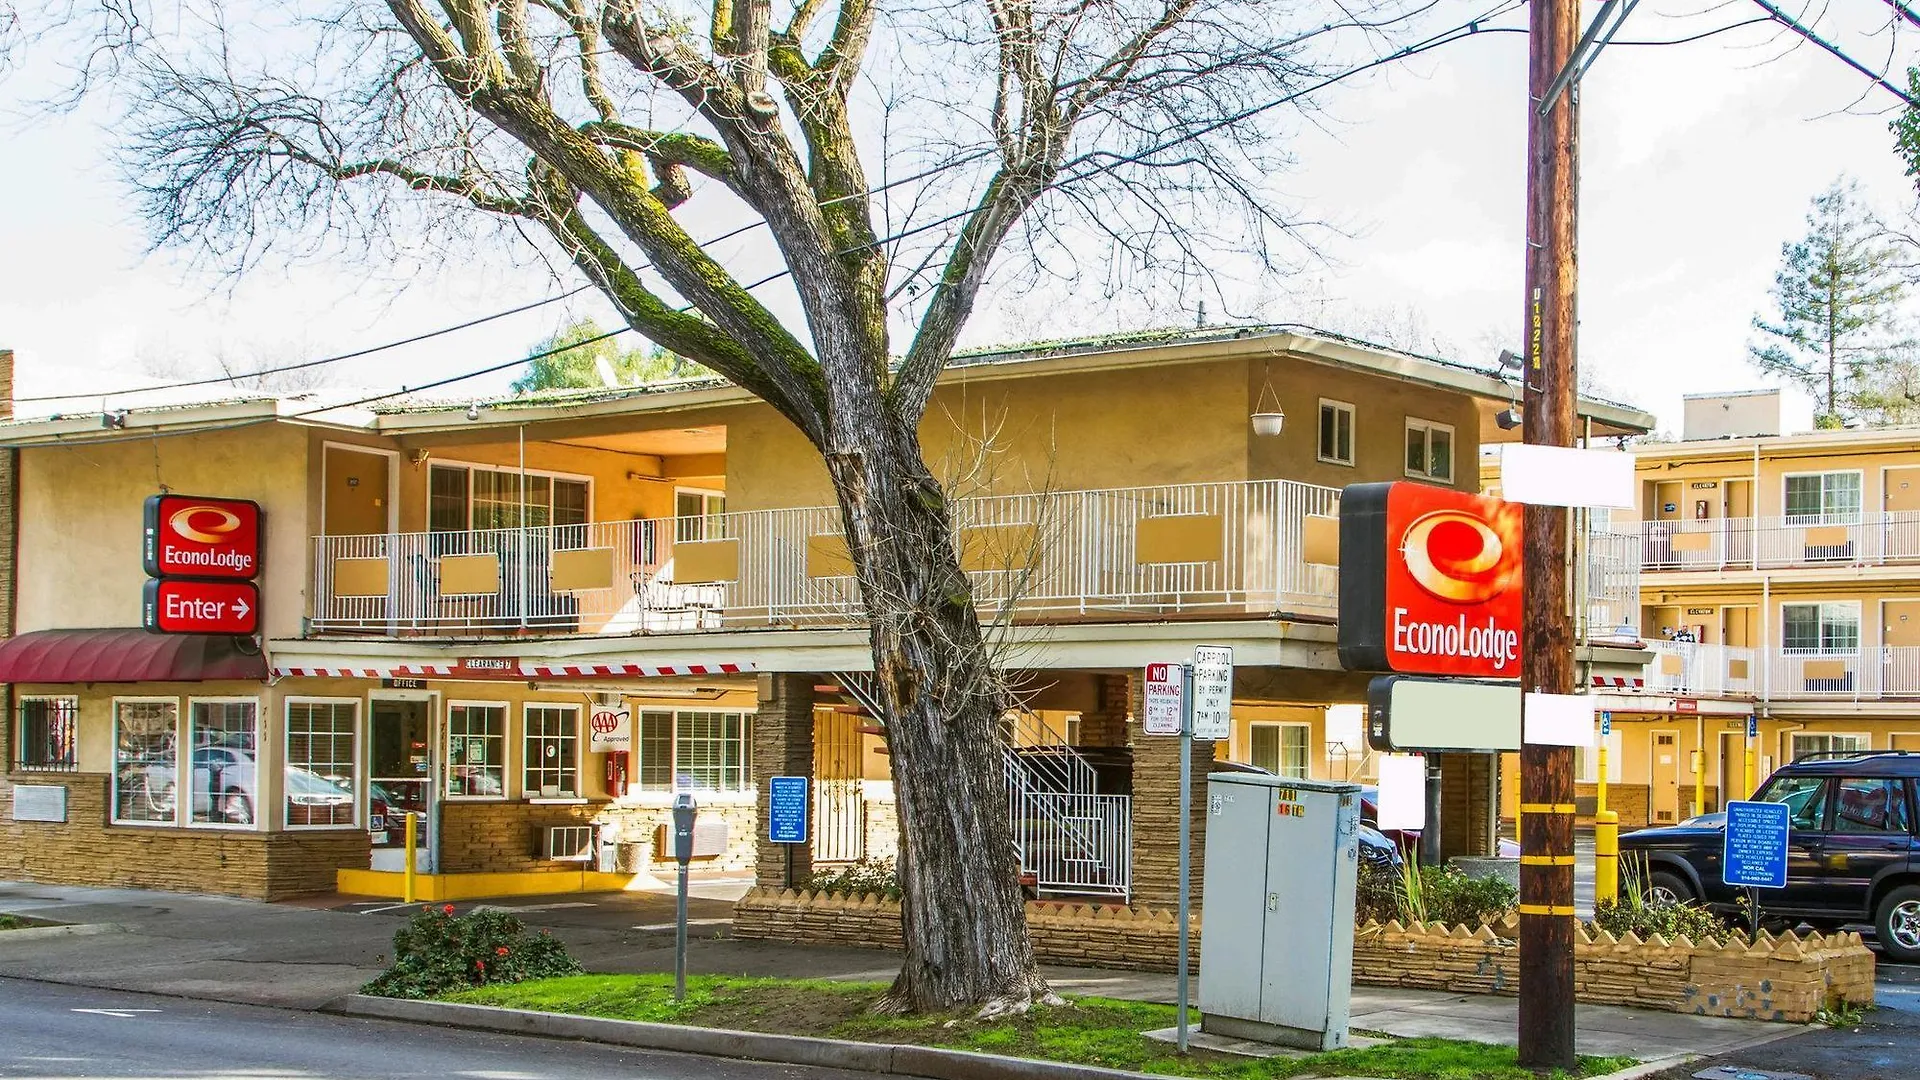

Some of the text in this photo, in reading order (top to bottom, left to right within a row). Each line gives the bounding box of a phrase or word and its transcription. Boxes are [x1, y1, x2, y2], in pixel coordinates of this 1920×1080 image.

[165, 545, 251, 571] EconoLodge
[166, 594, 226, 619] Enter
[1394, 607, 1518, 670] EconoLodge
[1197, 651, 1230, 665] CARPOOL
[1152, 666, 1166, 680] NO
[1198, 668, 1228, 682] PARKING
[394, 680, 417, 688] OFFICE
[1148, 684, 1180, 696] PARKING
[1199, 685, 1227, 694] BY PERMIT
[1206, 698, 1218, 708] ONLY
[594, 712, 616, 732] AAA
[1280, 789, 1296, 800] 711
